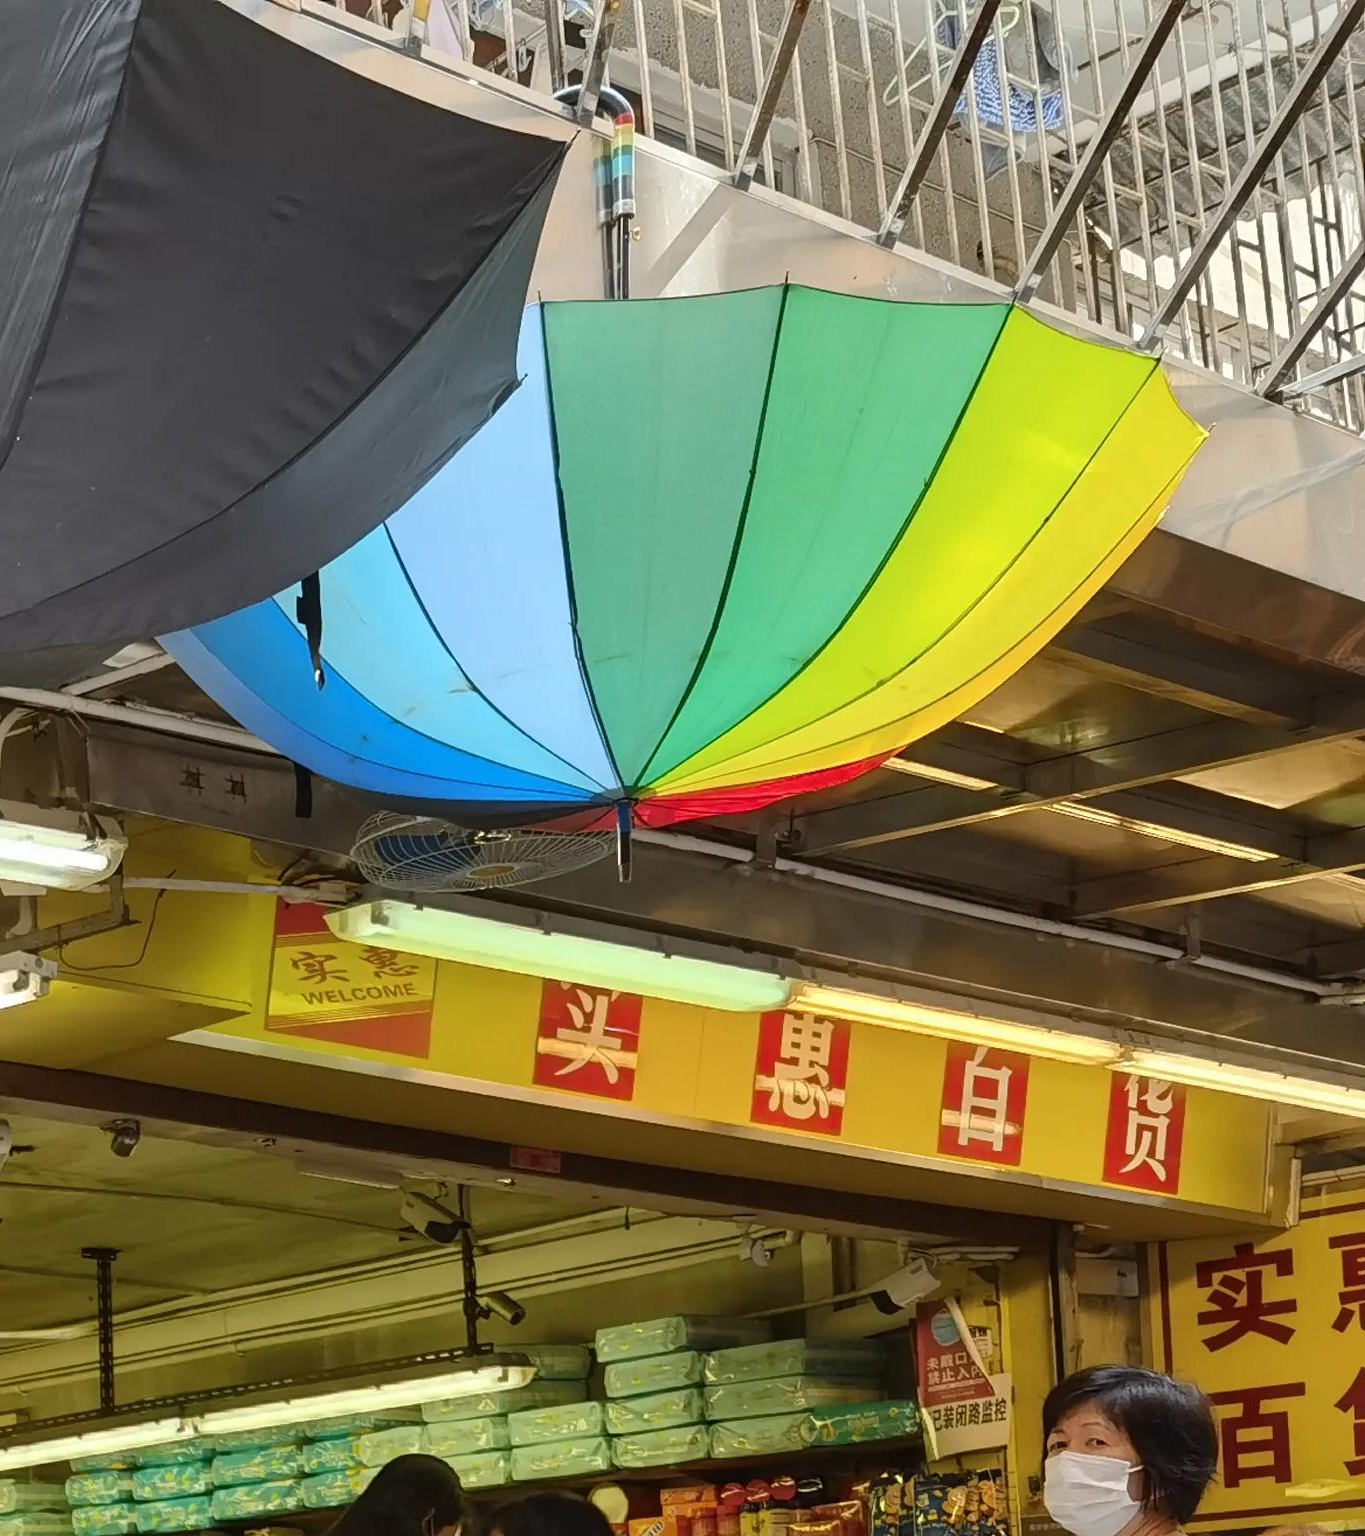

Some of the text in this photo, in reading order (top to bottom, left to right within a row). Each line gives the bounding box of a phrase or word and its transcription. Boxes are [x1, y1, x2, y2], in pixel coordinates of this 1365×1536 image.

[301, 982, 419, 1006] WELCOME
[926, 1352, 981, 1371] 未戴口
